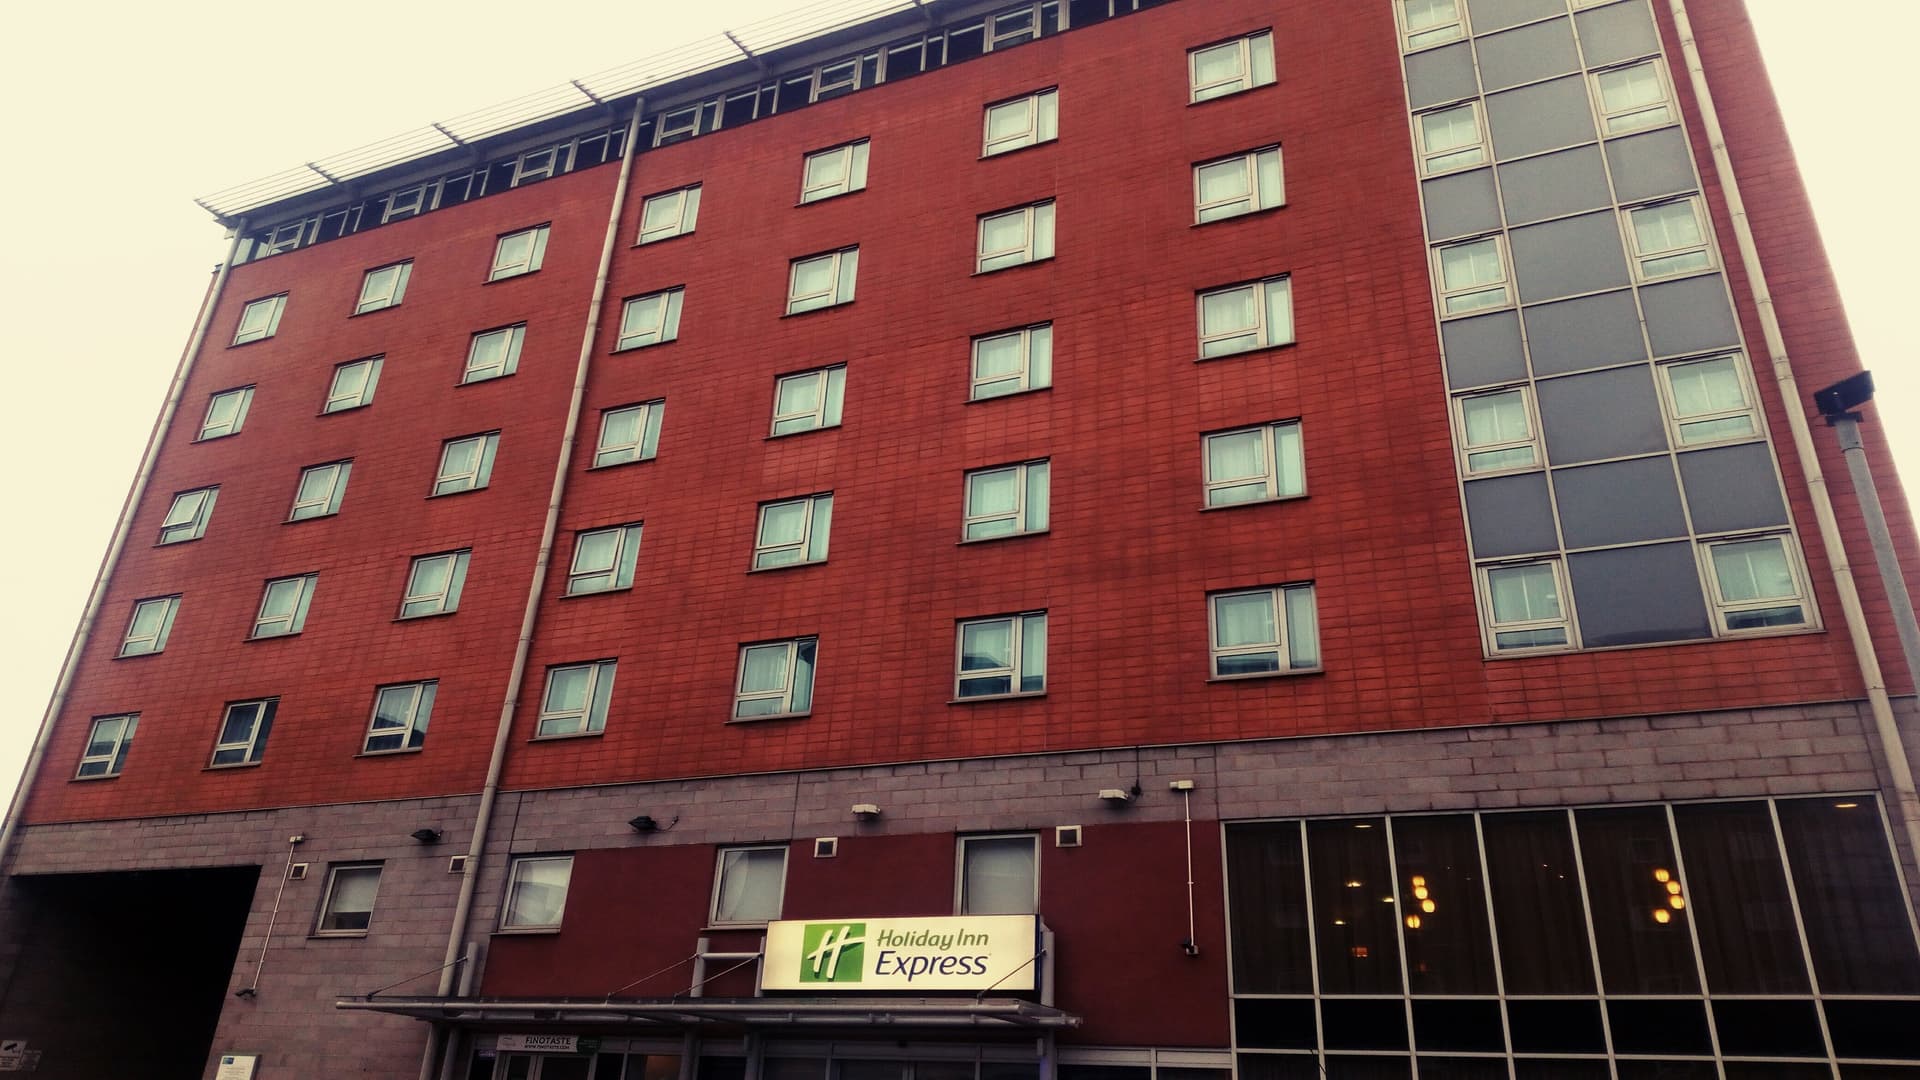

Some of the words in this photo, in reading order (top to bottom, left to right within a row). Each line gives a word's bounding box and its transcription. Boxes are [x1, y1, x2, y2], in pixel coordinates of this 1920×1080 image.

[877, 929, 954, 951] Holiday
[957, 928, 989, 946] Inn
[875, 950, 989, 982] Express
[525, 1036, 571, 1045] FINOTASTE
